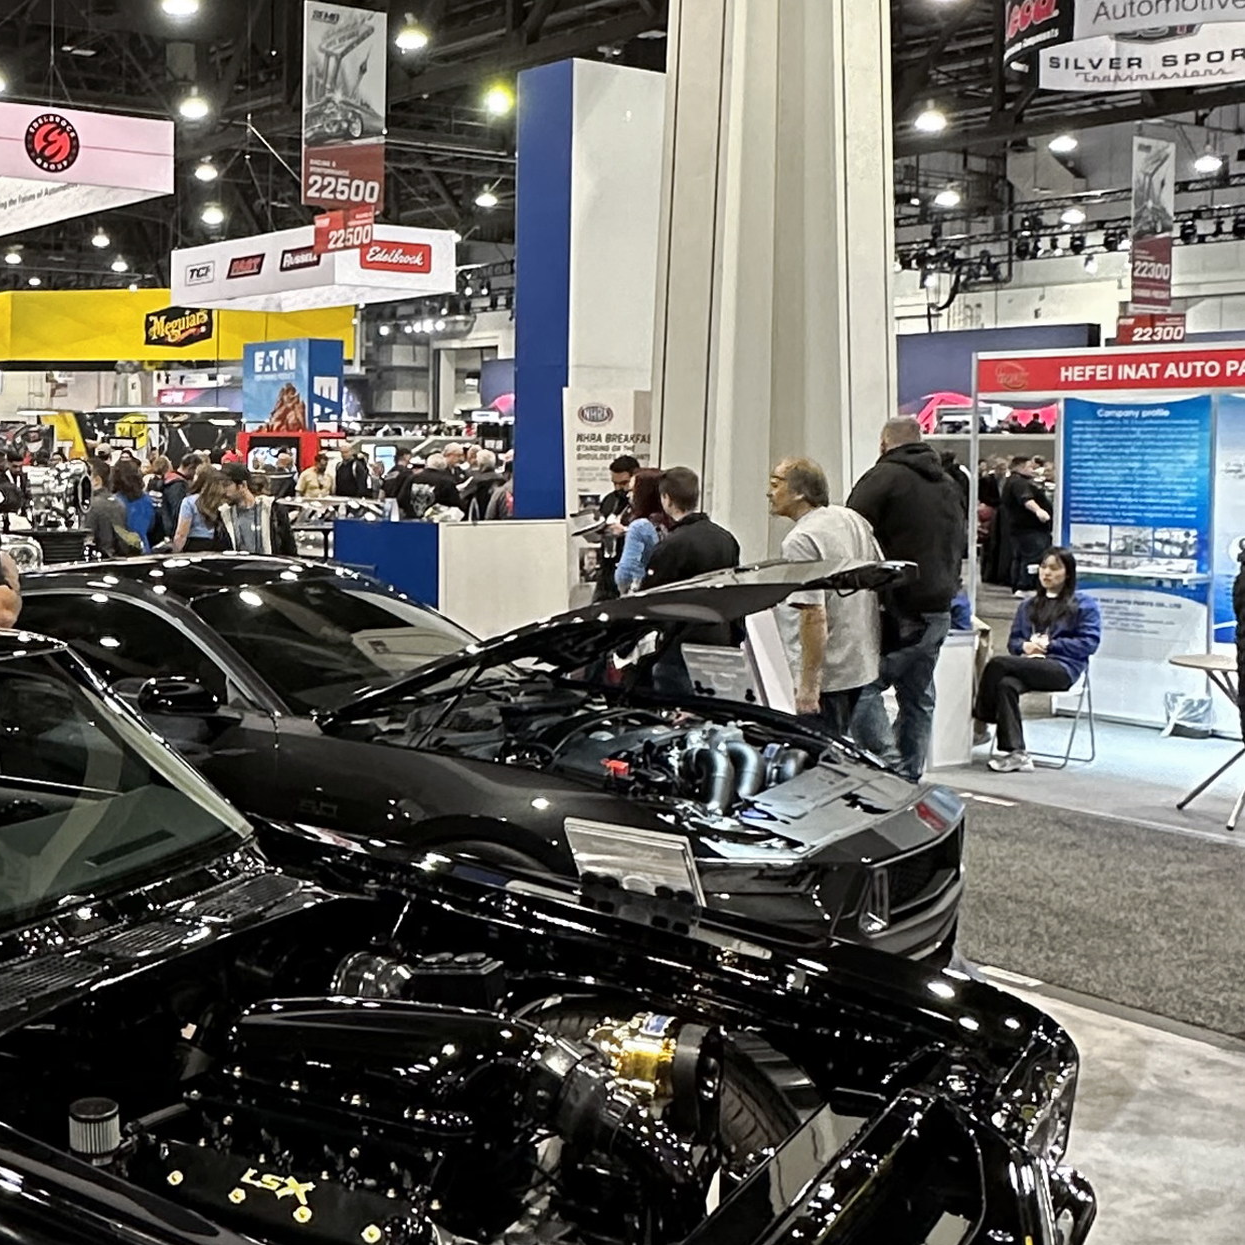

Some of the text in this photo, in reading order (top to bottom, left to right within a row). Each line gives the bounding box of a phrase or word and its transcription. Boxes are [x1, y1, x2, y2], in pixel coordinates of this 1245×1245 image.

[1049, 56, 1142, 70] SILVER
[1075, 66, 1234, 83] Transmissions
[29, 115, 76, 138] EDELBROCK
[35, 157, 69, 170] GROUP
[306, 175, 380, 203] 22500
[327, 224, 372, 249] 22500
[366, 246, 424, 266] Edelbrock
[1133, 260, 1170, 279] 22300
[1132, 325, 1185, 341] 22300
[254, 348, 296, 373] EATON
[1060, 364, 1113, 382] HEFEI
[1118, 363, 1161, 380] INAT
[1163, 361, 1221, 379] AUTO
[583, 406, 609, 421] NHRA
[1096, 408, 1171, 418] Company profile
[240, 1167, 316, 1206] LSX
